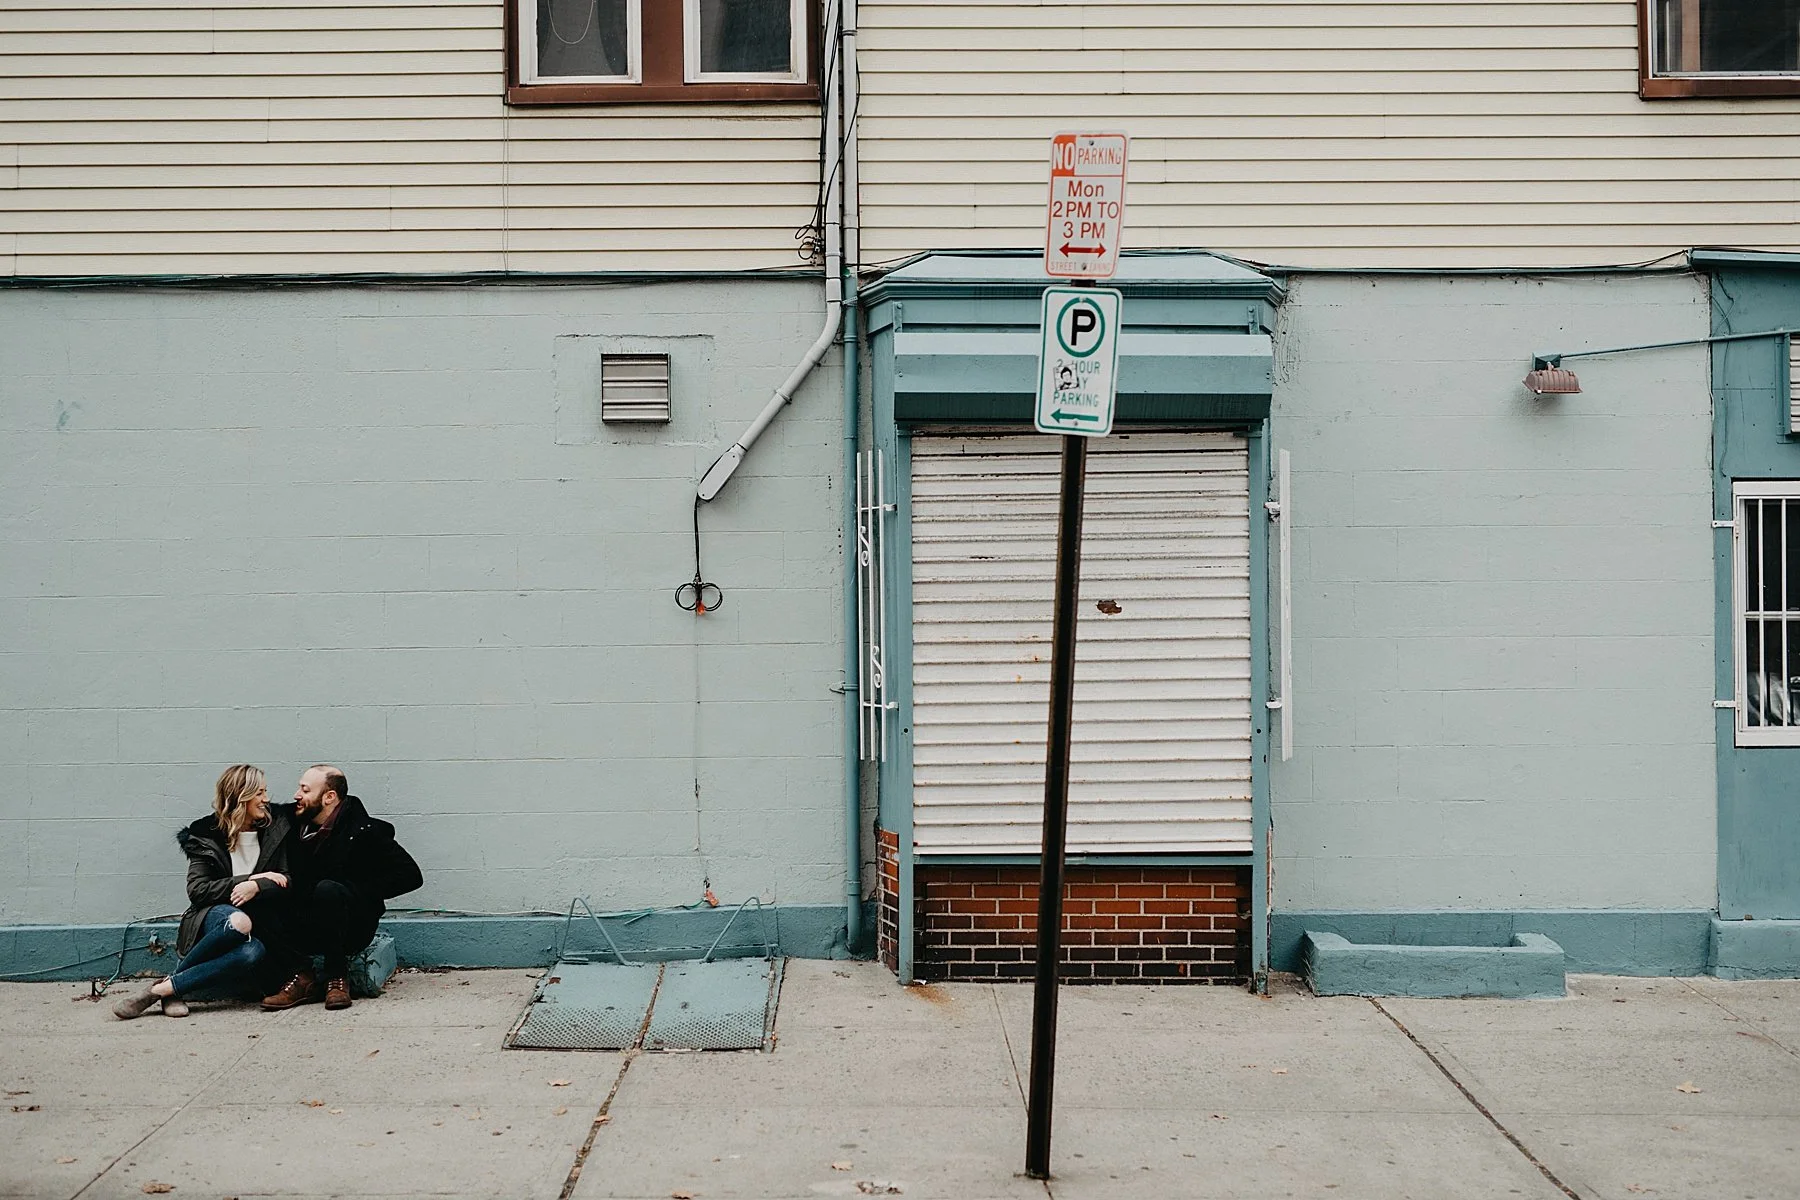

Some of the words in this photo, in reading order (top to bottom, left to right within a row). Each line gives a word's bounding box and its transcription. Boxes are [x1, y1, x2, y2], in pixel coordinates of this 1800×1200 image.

[1053, 142, 1075, 170] NO
[1077, 147, 1121, 165] PARKING
[1068, 180, 1104, 197] Mon
[1097, 201, 1119, 219] TO
[1063, 221, 1073, 238] 3
[1080, 222, 1105, 238] PM
[1071, 308, 1096, 346] P
[1053, 390, 1099, 407] PARKING
